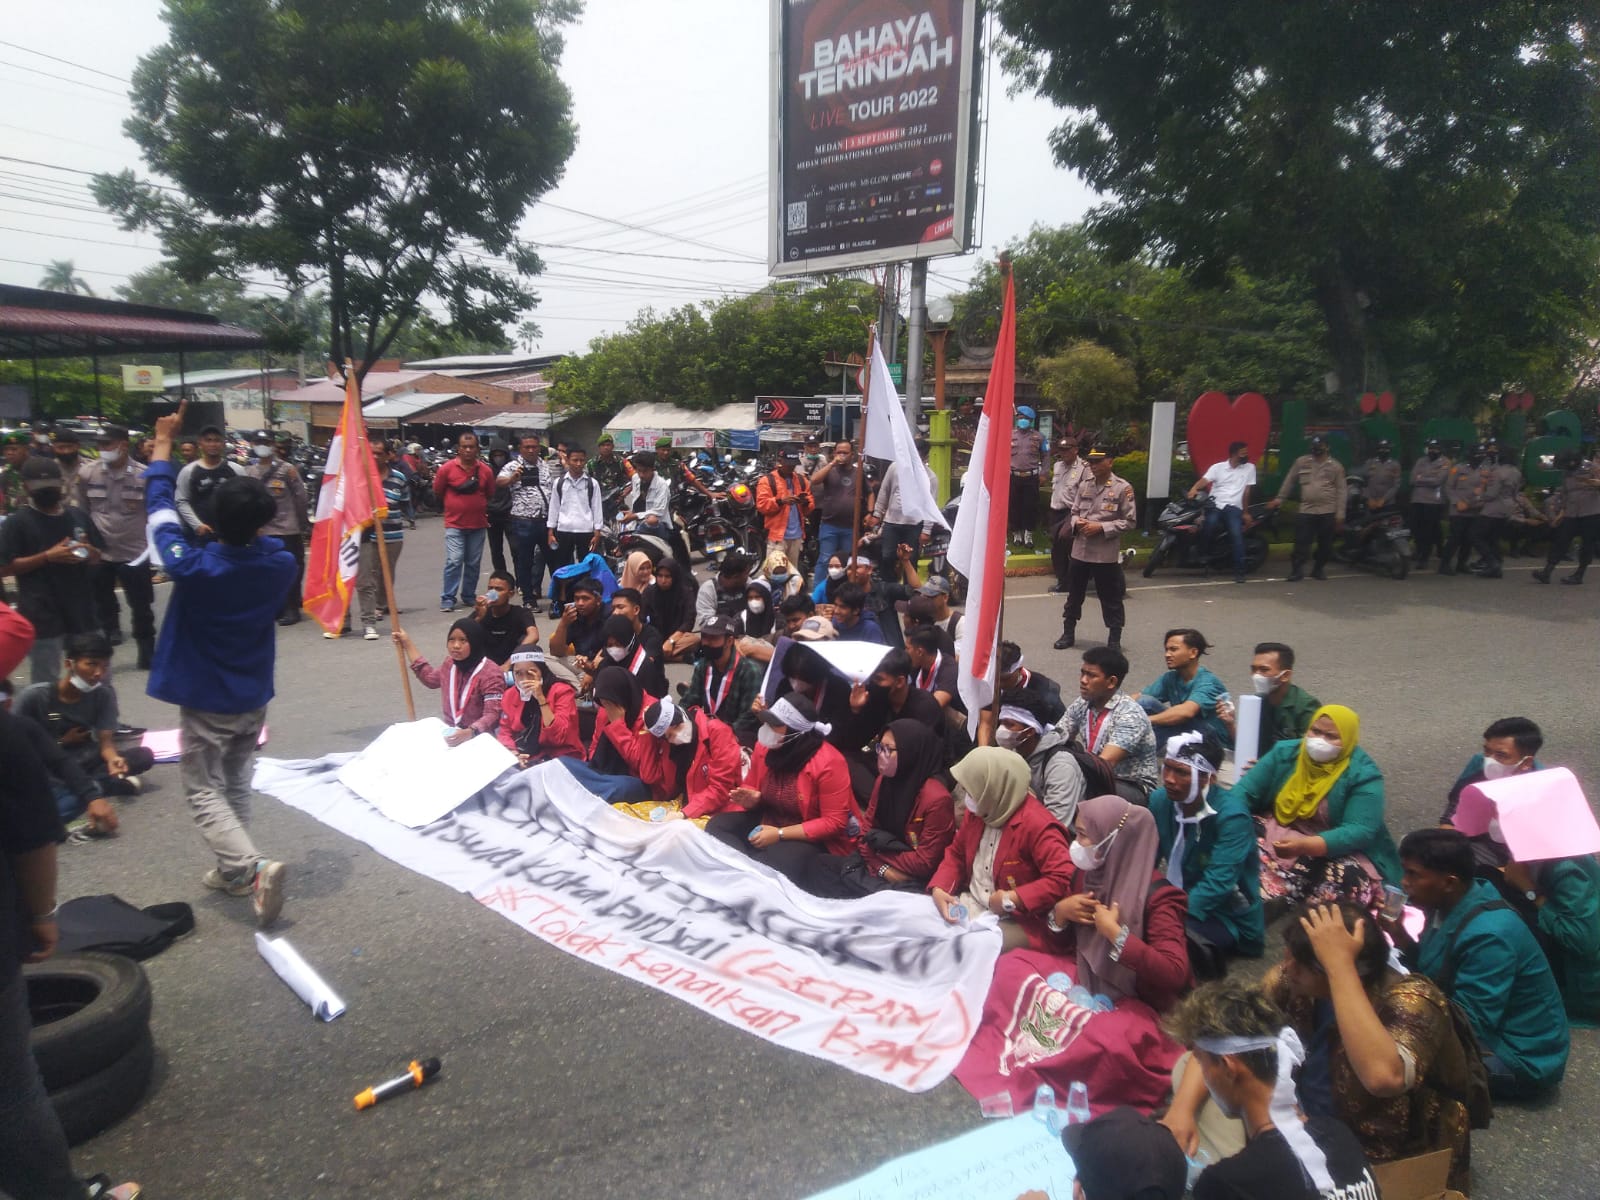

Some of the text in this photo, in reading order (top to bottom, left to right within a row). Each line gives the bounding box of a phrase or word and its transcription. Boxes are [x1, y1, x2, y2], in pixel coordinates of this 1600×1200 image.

[814, 12, 937, 69] BAHAYA
[798, 36, 953, 100] TERINDAH
[810, 86, 938, 130] LIVE TOUR 2022
[797, 132, 952, 170] MEDAN INTERNATIONAL CONVENTION CENTER
[815, 143, 843, 154] MEDAN
[856, 129, 906, 146] SEPTEMBER
